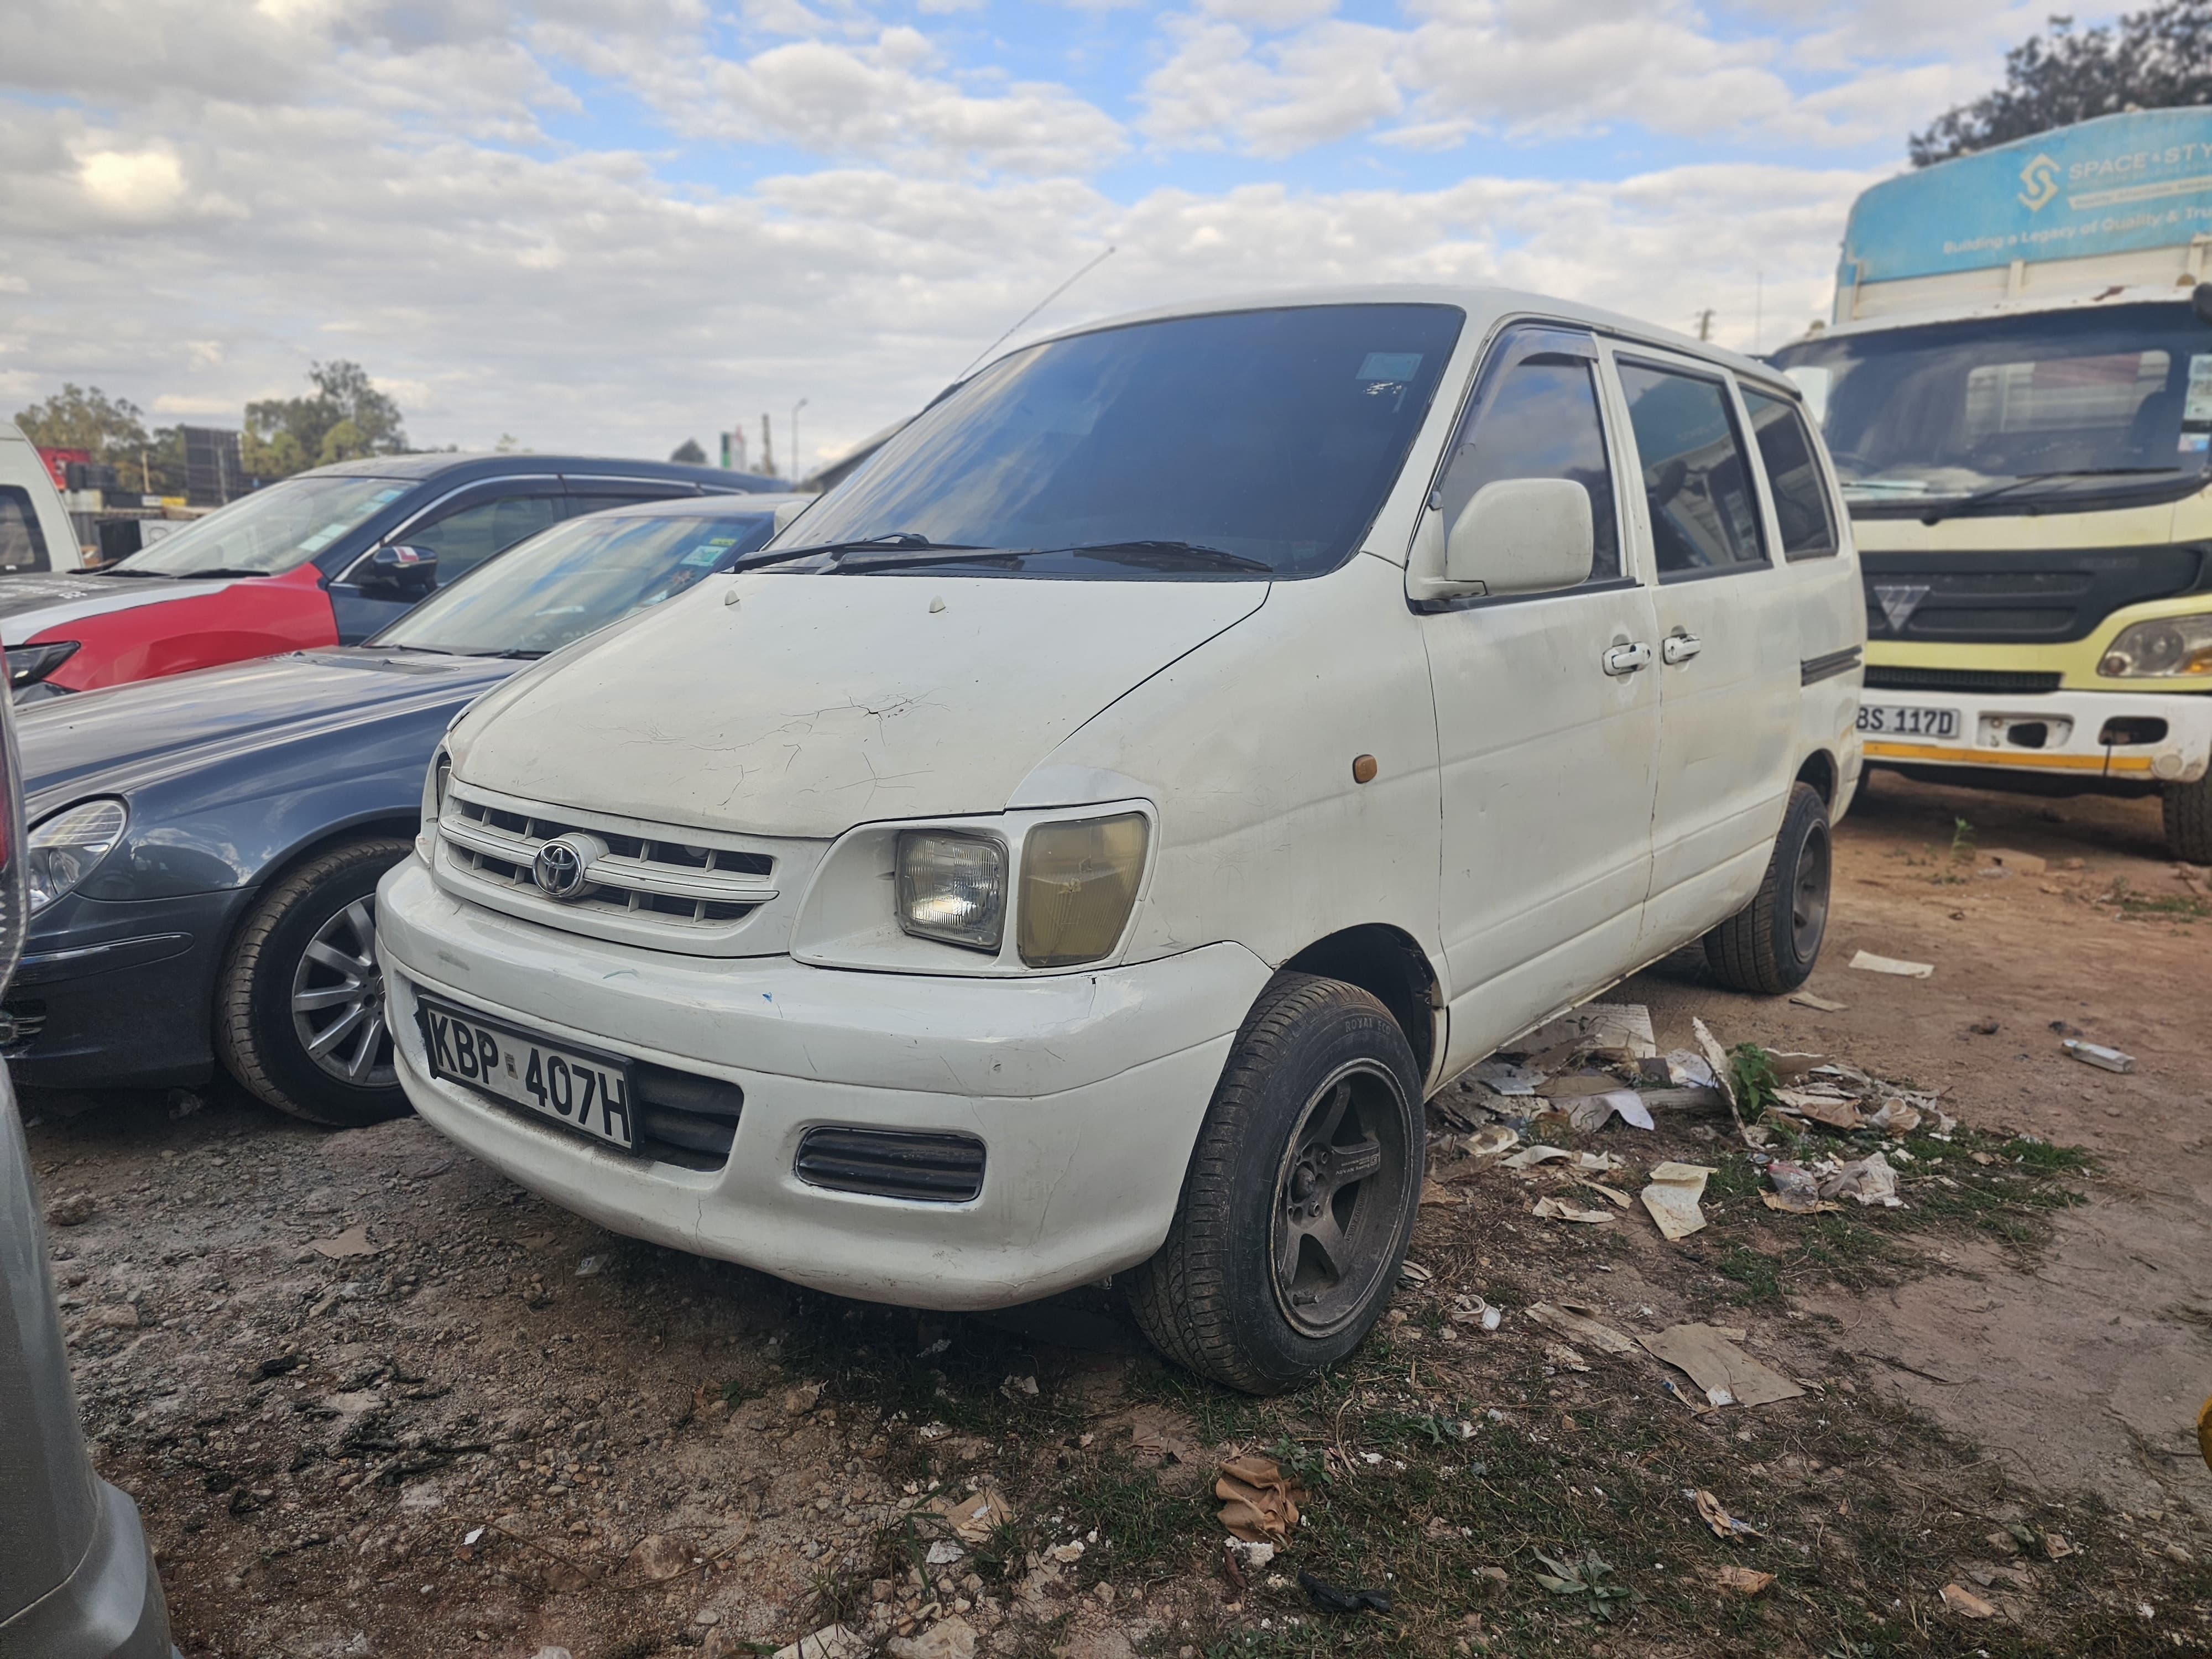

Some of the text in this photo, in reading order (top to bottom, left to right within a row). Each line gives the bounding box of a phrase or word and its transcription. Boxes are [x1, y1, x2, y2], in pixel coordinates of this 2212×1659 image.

[2069, 152, 2149, 180] SPACE
[1943, 236, 2004, 255] Building
[2021, 225, 2077, 243] Legacy
[2080, 220, 2098, 235] of
[2103, 212, 2162, 232] Quality
[2166, 210, 2178, 224] &
[1894, 708, 1953, 734] 117D
[430, 1011, 632, 1142] KBP 407H
[1335, 1167, 1355, 1175] ADVAN
